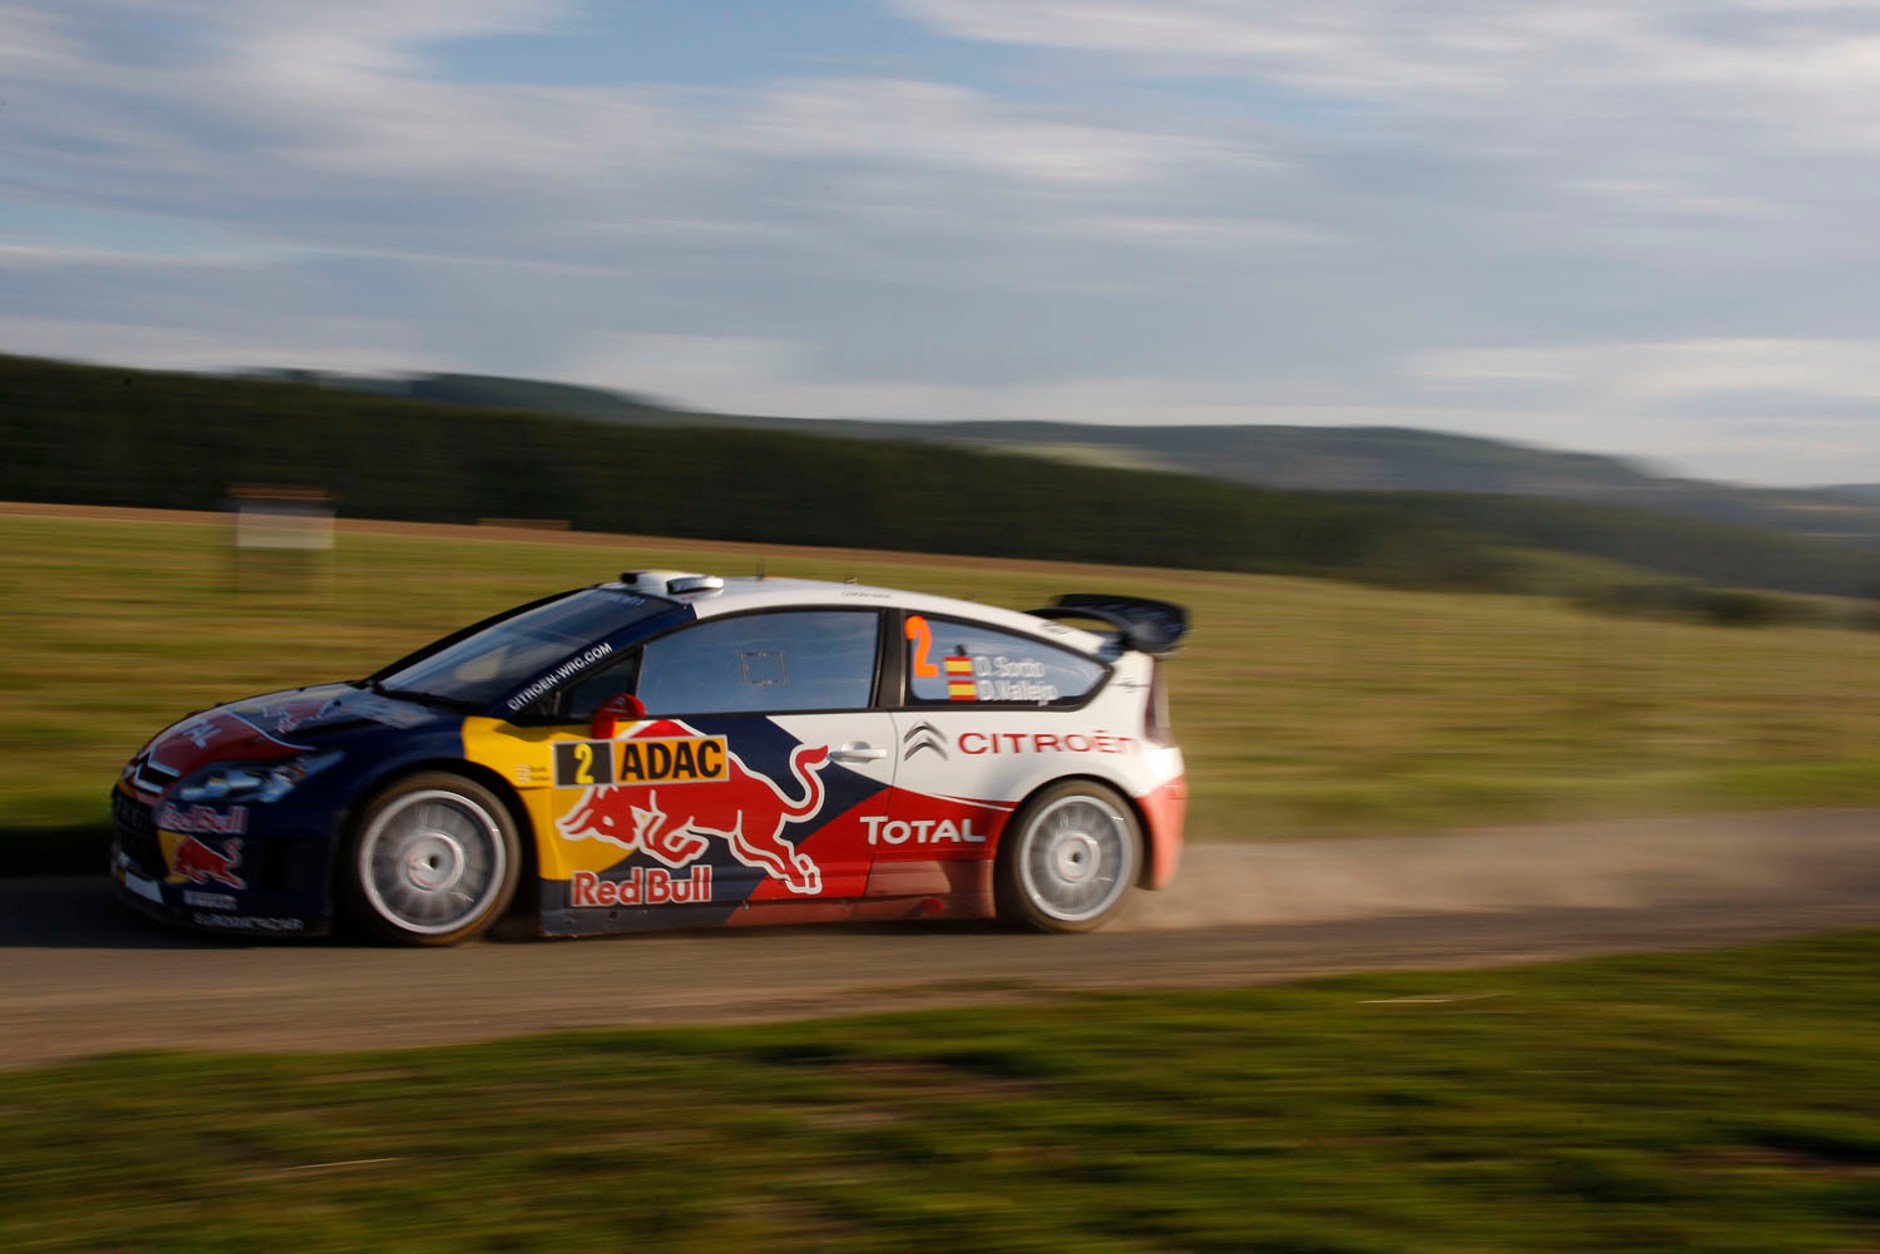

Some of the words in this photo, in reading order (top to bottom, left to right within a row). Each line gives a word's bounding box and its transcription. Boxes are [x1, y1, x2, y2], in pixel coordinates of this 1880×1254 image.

[905, 615, 939, 677] 2
[574, 743, 594, 784] 2
[620, 740, 722, 781] ADAC
[859, 815, 987, 845] TOTAL
[571, 867, 643, 907] Red
[645, 864, 712, 904] Bull
